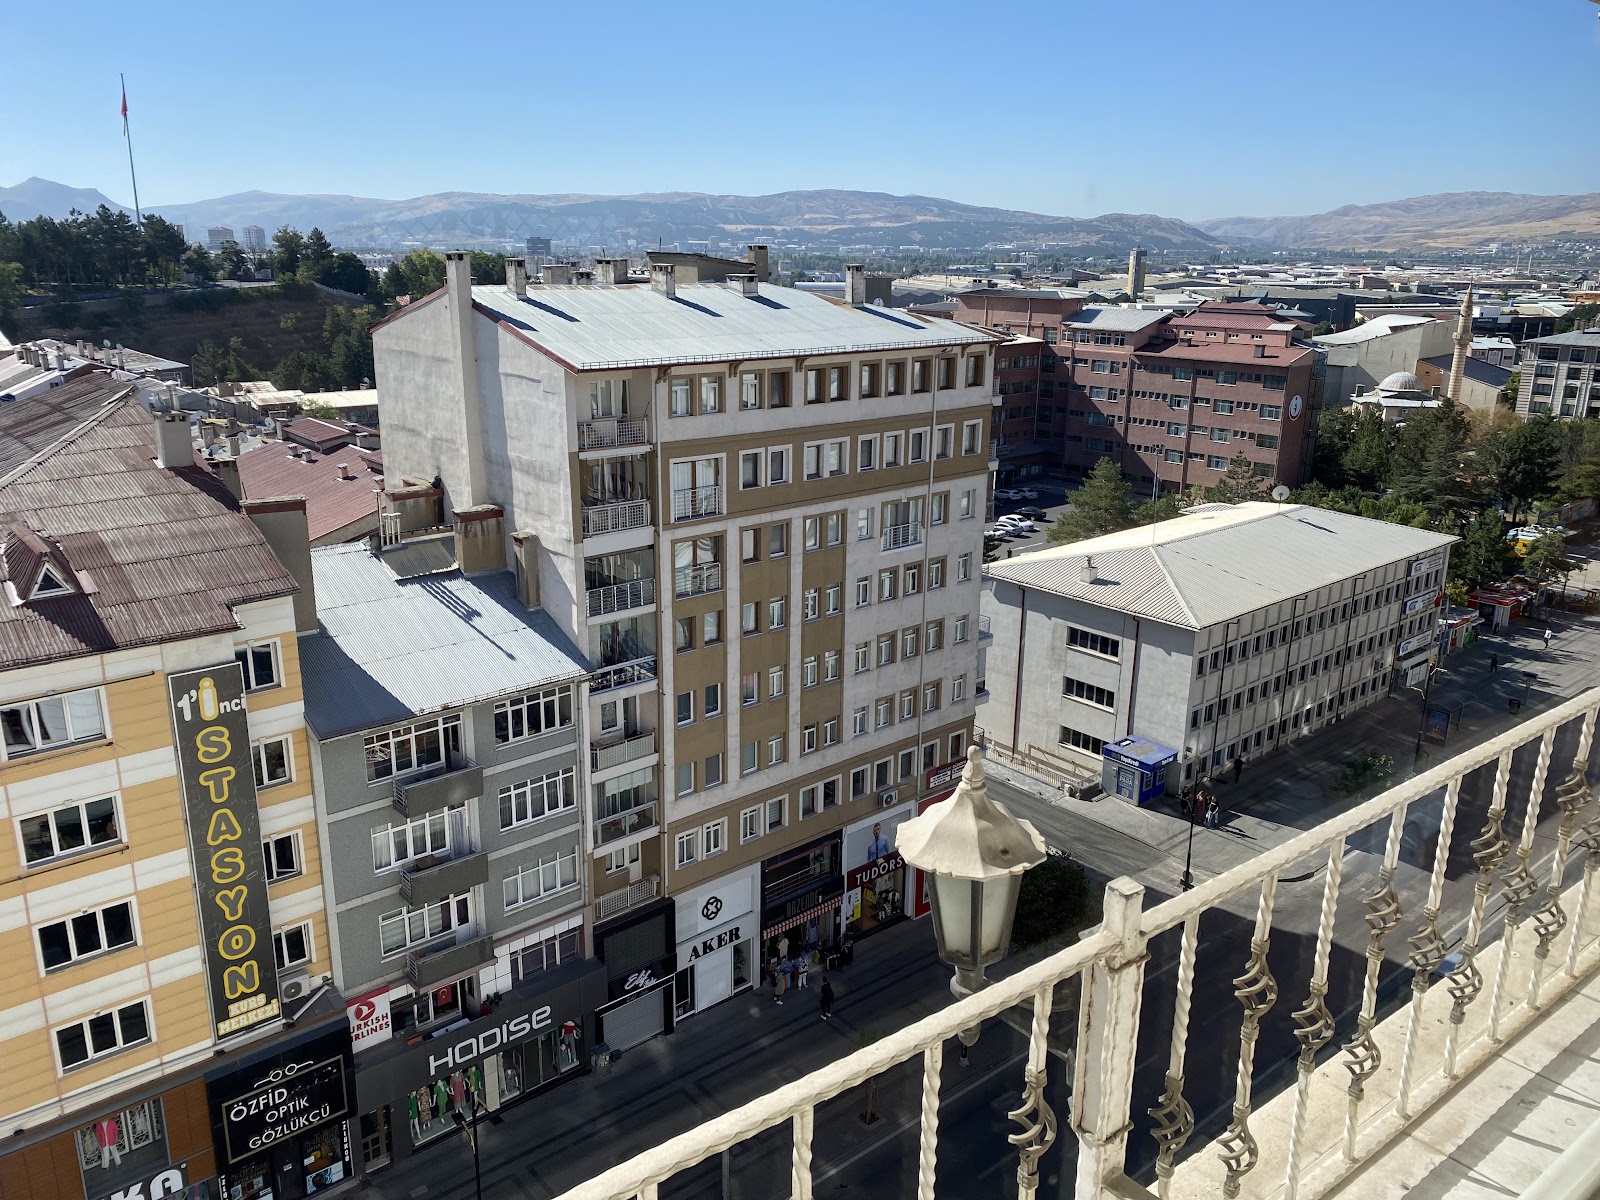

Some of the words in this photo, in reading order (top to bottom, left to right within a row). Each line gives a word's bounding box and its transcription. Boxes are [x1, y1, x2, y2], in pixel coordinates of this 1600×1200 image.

[856, 855, 904, 886] TUDORS
[687, 926, 742, 963] AKER
[217, 998, 280, 1036] MERKEZİ
[228, 993, 267, 1018] KURS
[351, 1012, 389, 1034] URKISH
[230, 1088, 287, 1121] ÖZFİD
[265, 1096, 310, 1123] OPTİK
[248, 1103, 330, 1149] GÖZLÜKÇÜ
